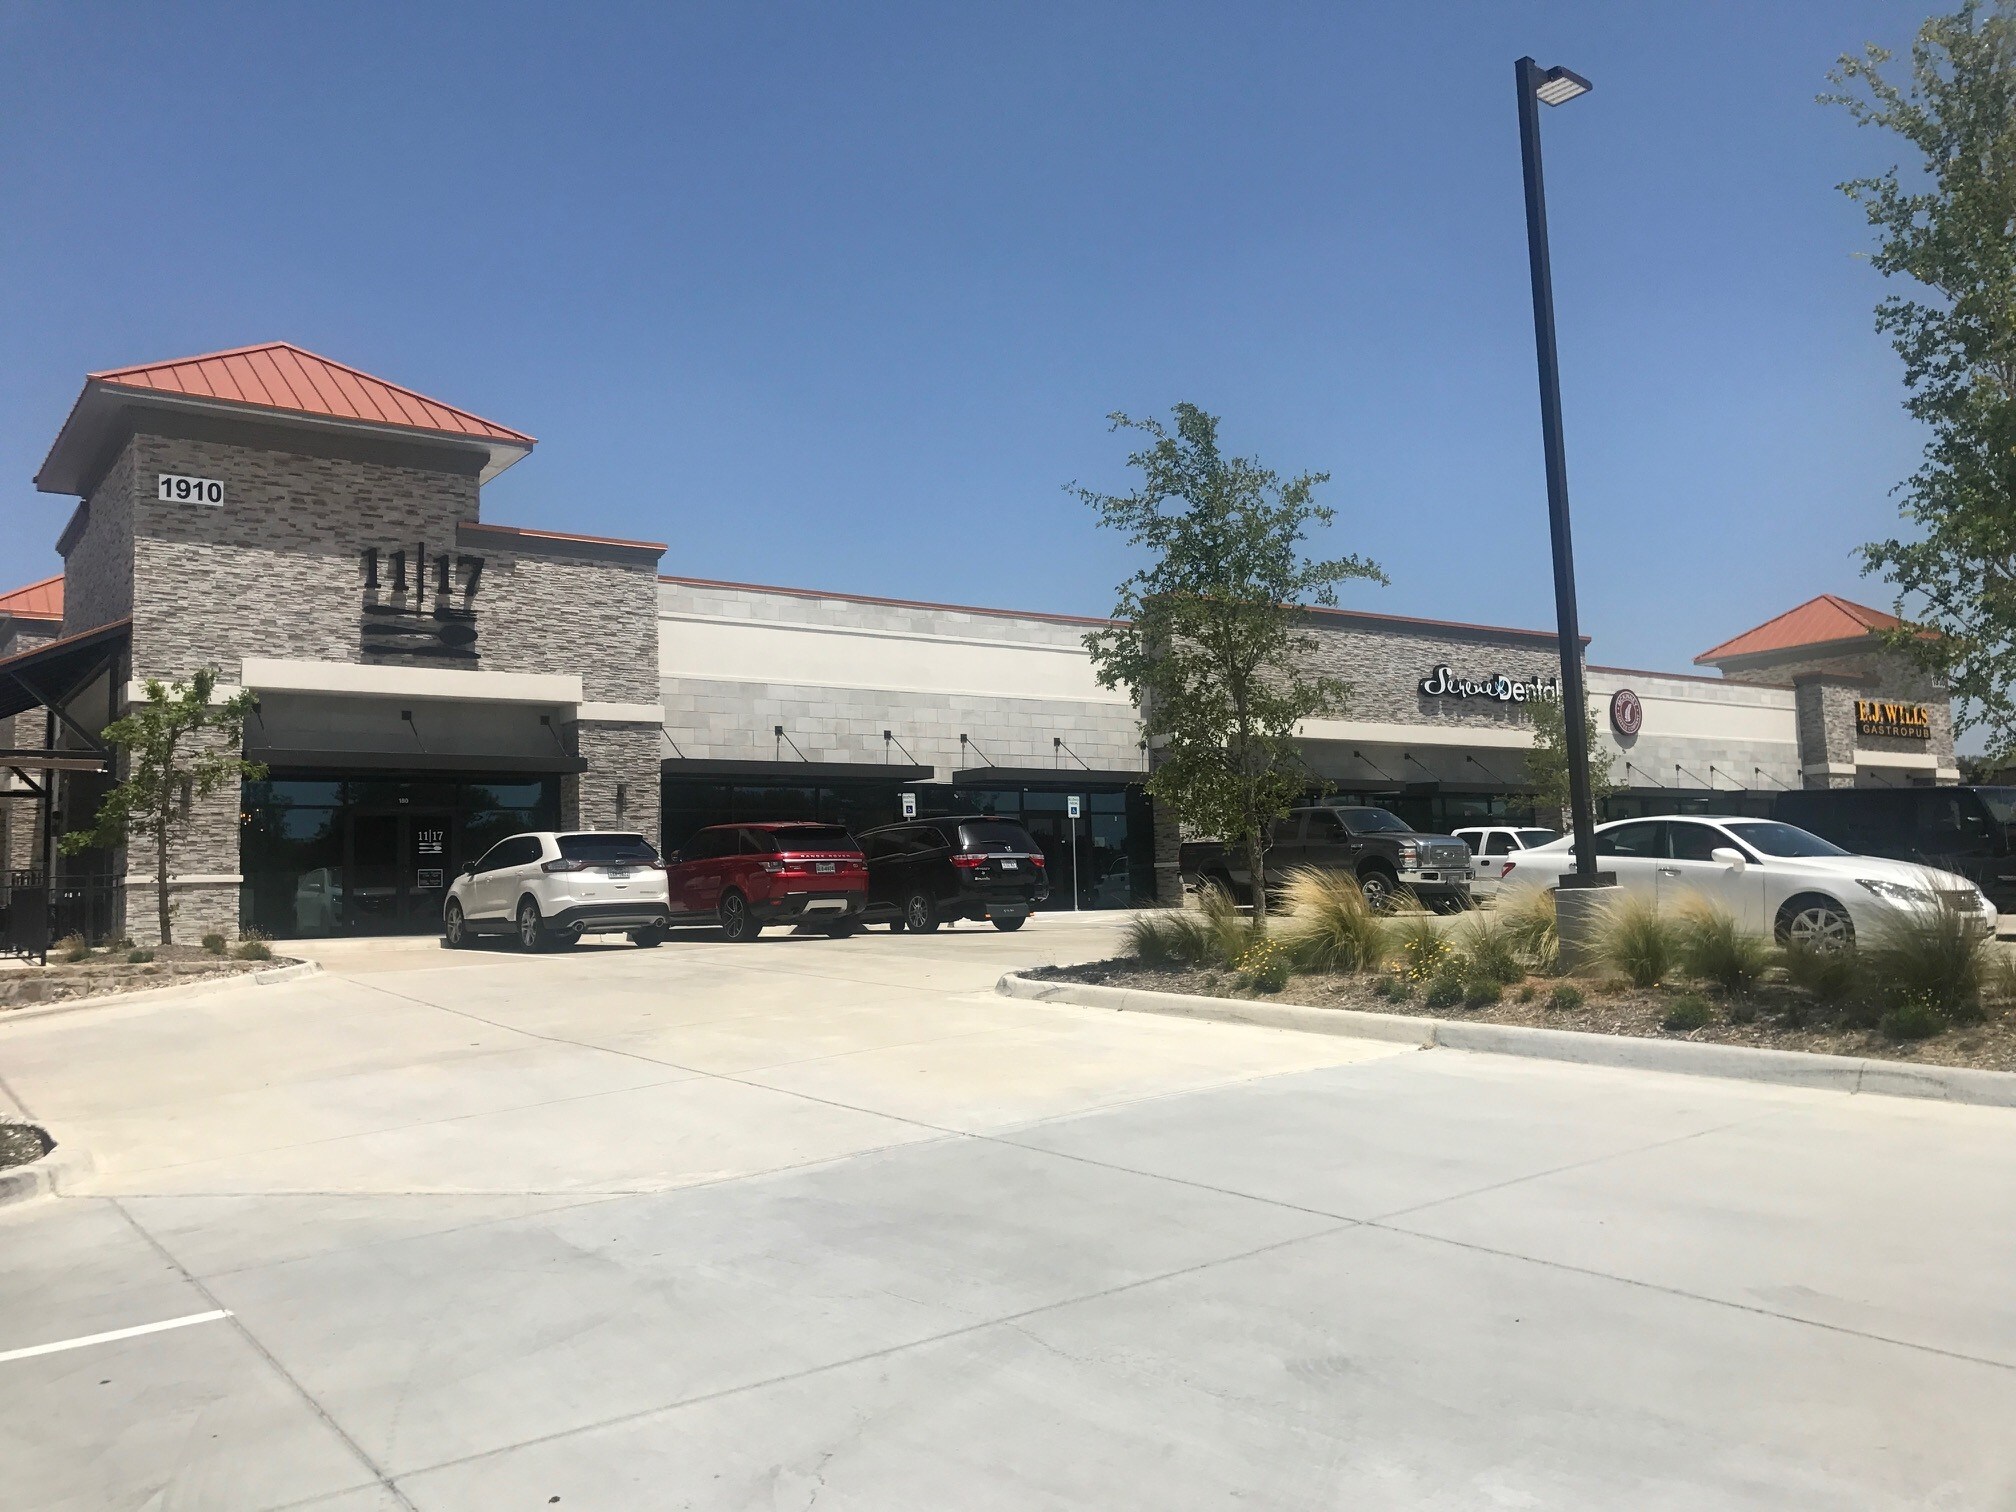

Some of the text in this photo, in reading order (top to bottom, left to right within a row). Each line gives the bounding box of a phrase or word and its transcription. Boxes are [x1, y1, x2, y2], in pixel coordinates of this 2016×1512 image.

[161, 477, 222, 503] 1910
[1421, 667, 1560, 704] Serene Dental
[1884, 703, 1929, 727] WILLS
[1862, 724, 1930, 739] GASTROPUB
